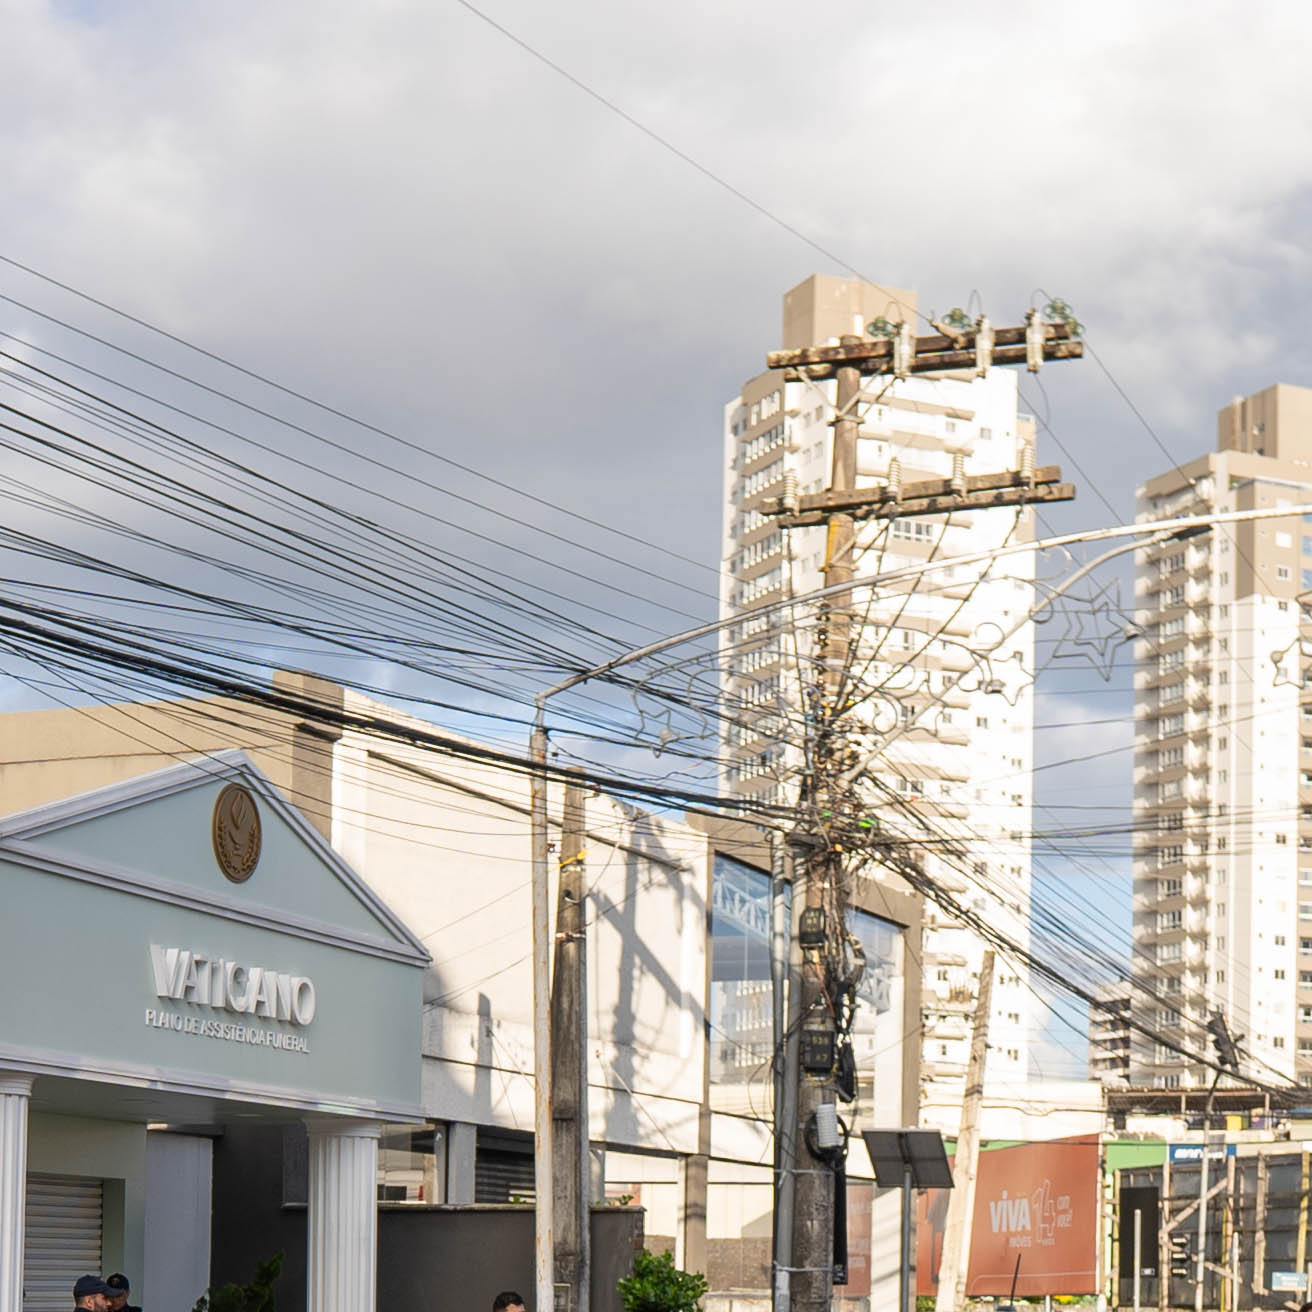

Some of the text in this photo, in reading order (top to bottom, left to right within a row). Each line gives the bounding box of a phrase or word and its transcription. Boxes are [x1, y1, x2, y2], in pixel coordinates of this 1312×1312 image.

[150, 944, 316, 1026] VATICANO
[145, 1008, 311, 1054] PLANO DE ASSISTÊNCIA FUNERAL
